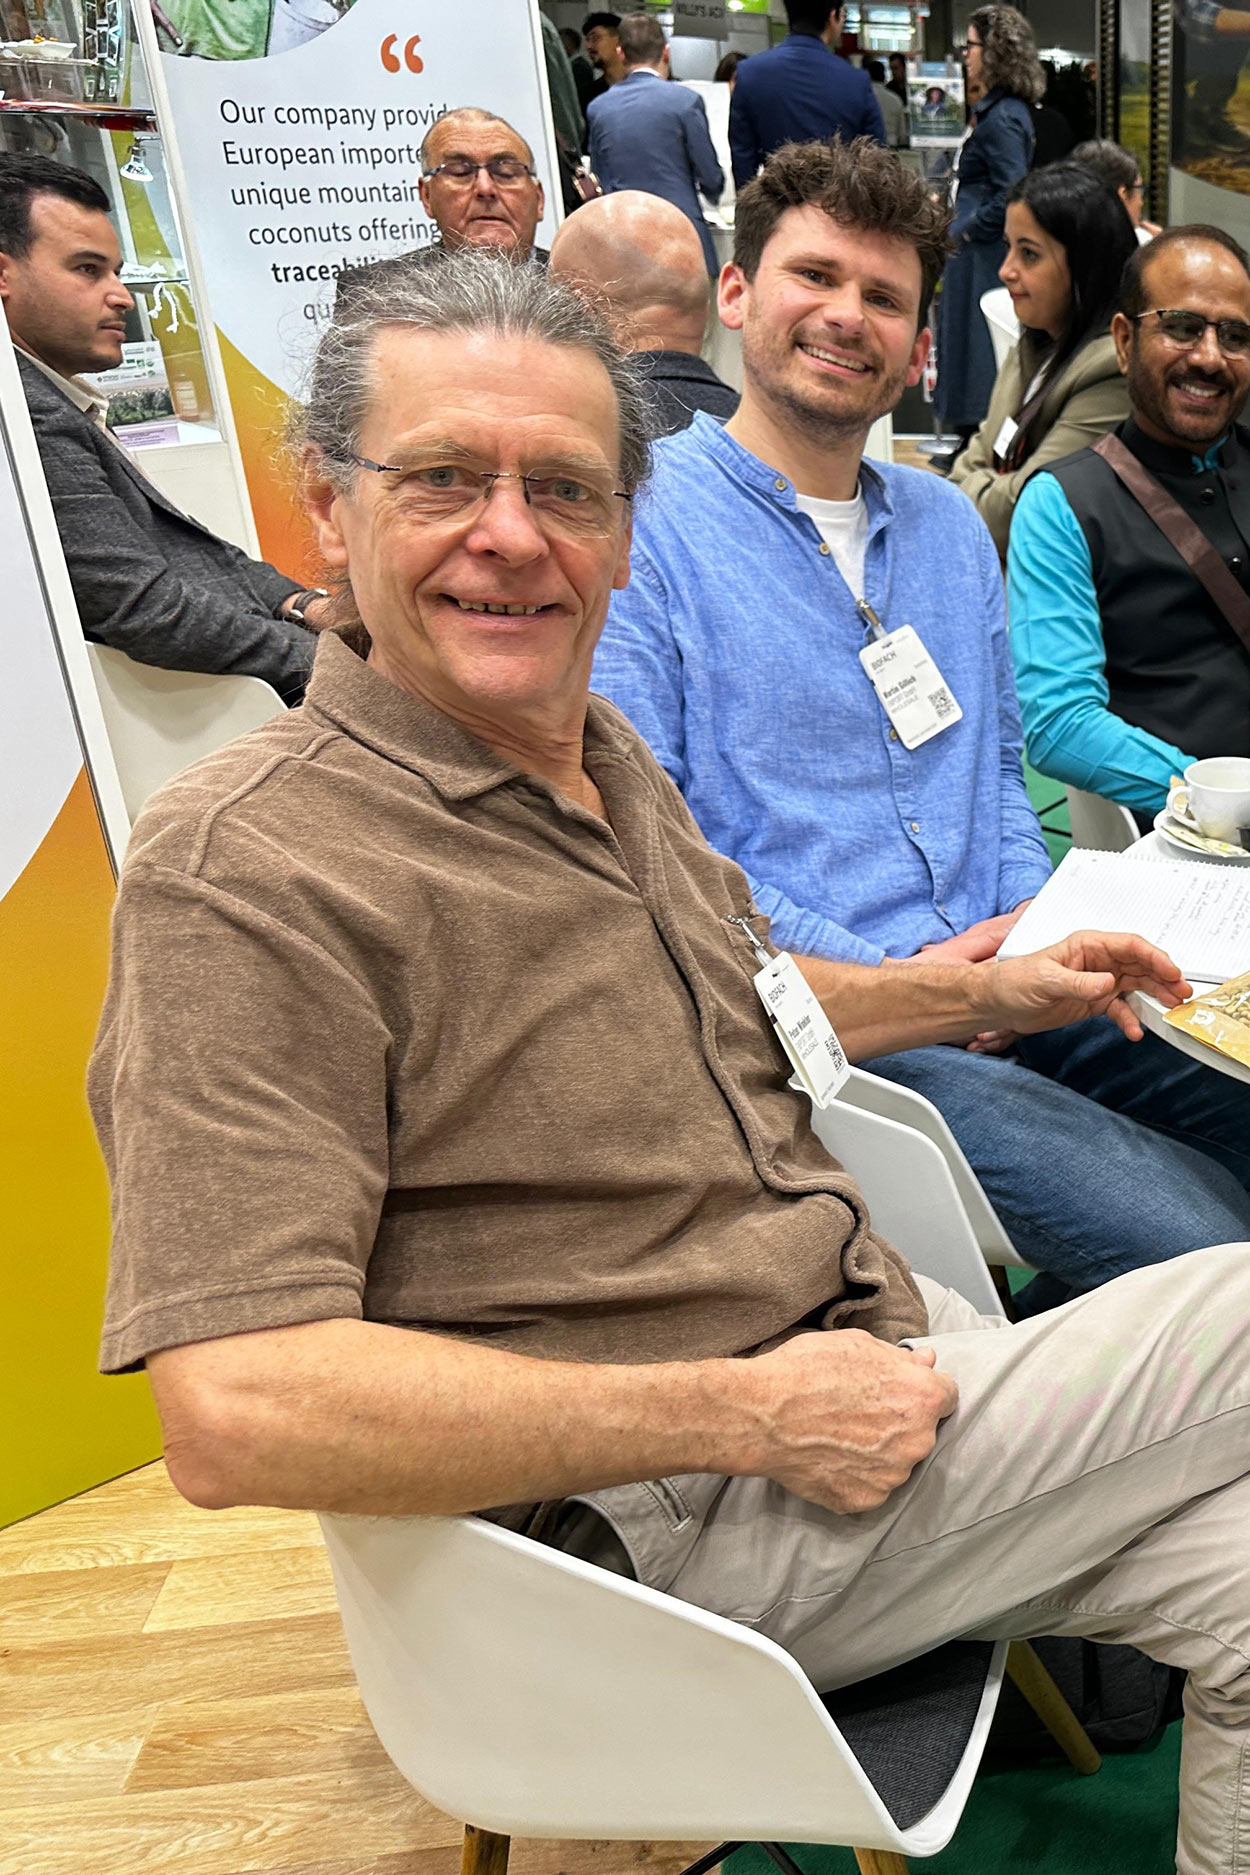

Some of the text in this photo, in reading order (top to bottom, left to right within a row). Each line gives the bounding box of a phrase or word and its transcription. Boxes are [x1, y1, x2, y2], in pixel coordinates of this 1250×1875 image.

[220, 98, 266, 124] Our
[274, 104, 376, 131] company
[222, 141, 335, 170] European
[231, 180, 420, 210] unique mountain
[249, 217, 443, 245] coconuts offering
[871, 650, 897, 671] BIOFACH
[768, 982, 788, 1004] BIOFACH
